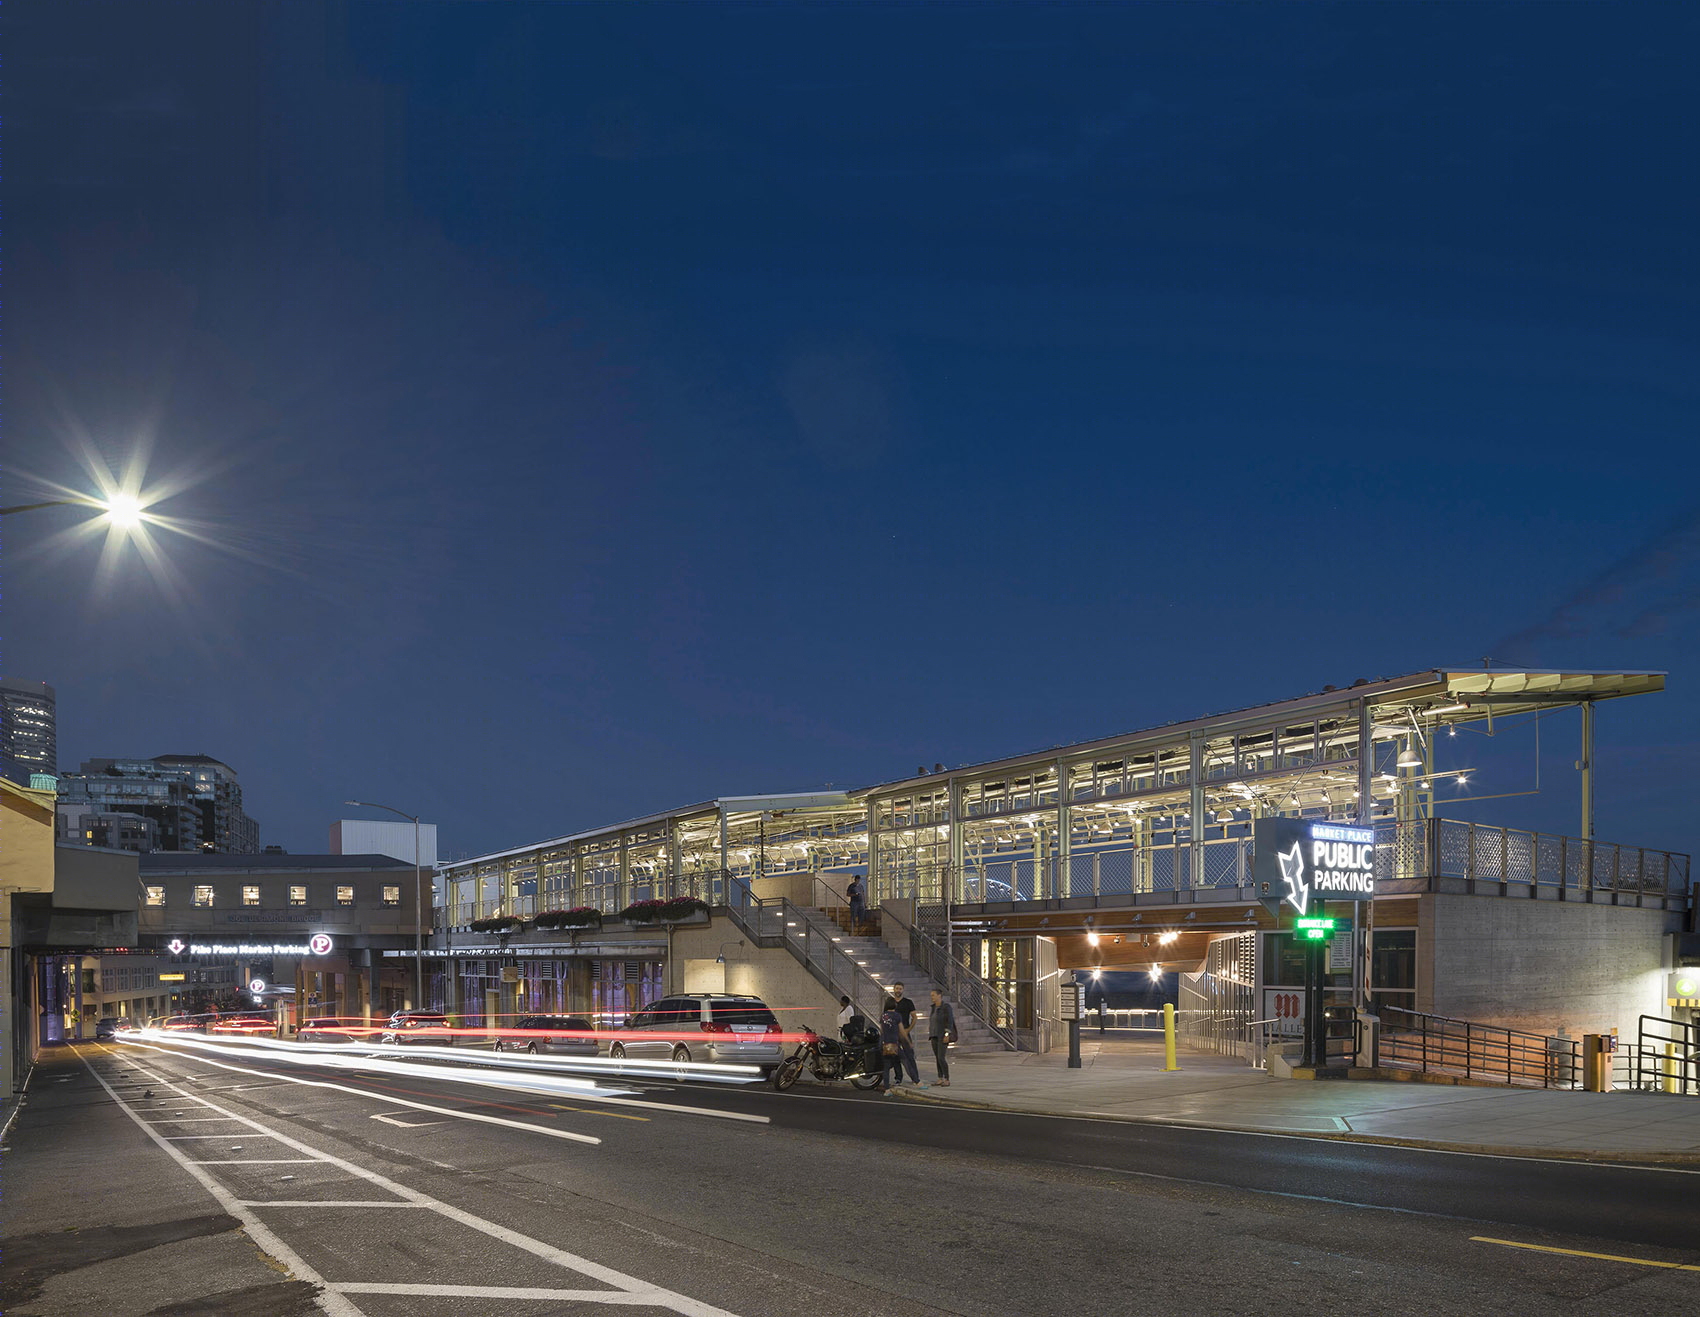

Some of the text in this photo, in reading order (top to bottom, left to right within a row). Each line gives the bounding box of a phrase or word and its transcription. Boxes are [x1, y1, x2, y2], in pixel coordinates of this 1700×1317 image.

[1313, 827, 1372, 842] MARKET PLACE
[1313, 841, 1373, 870] PUBLIC
[1314, 870, 1374, 893] PARKING
[190, 944, 310, 955] Pike Place Market Parking
